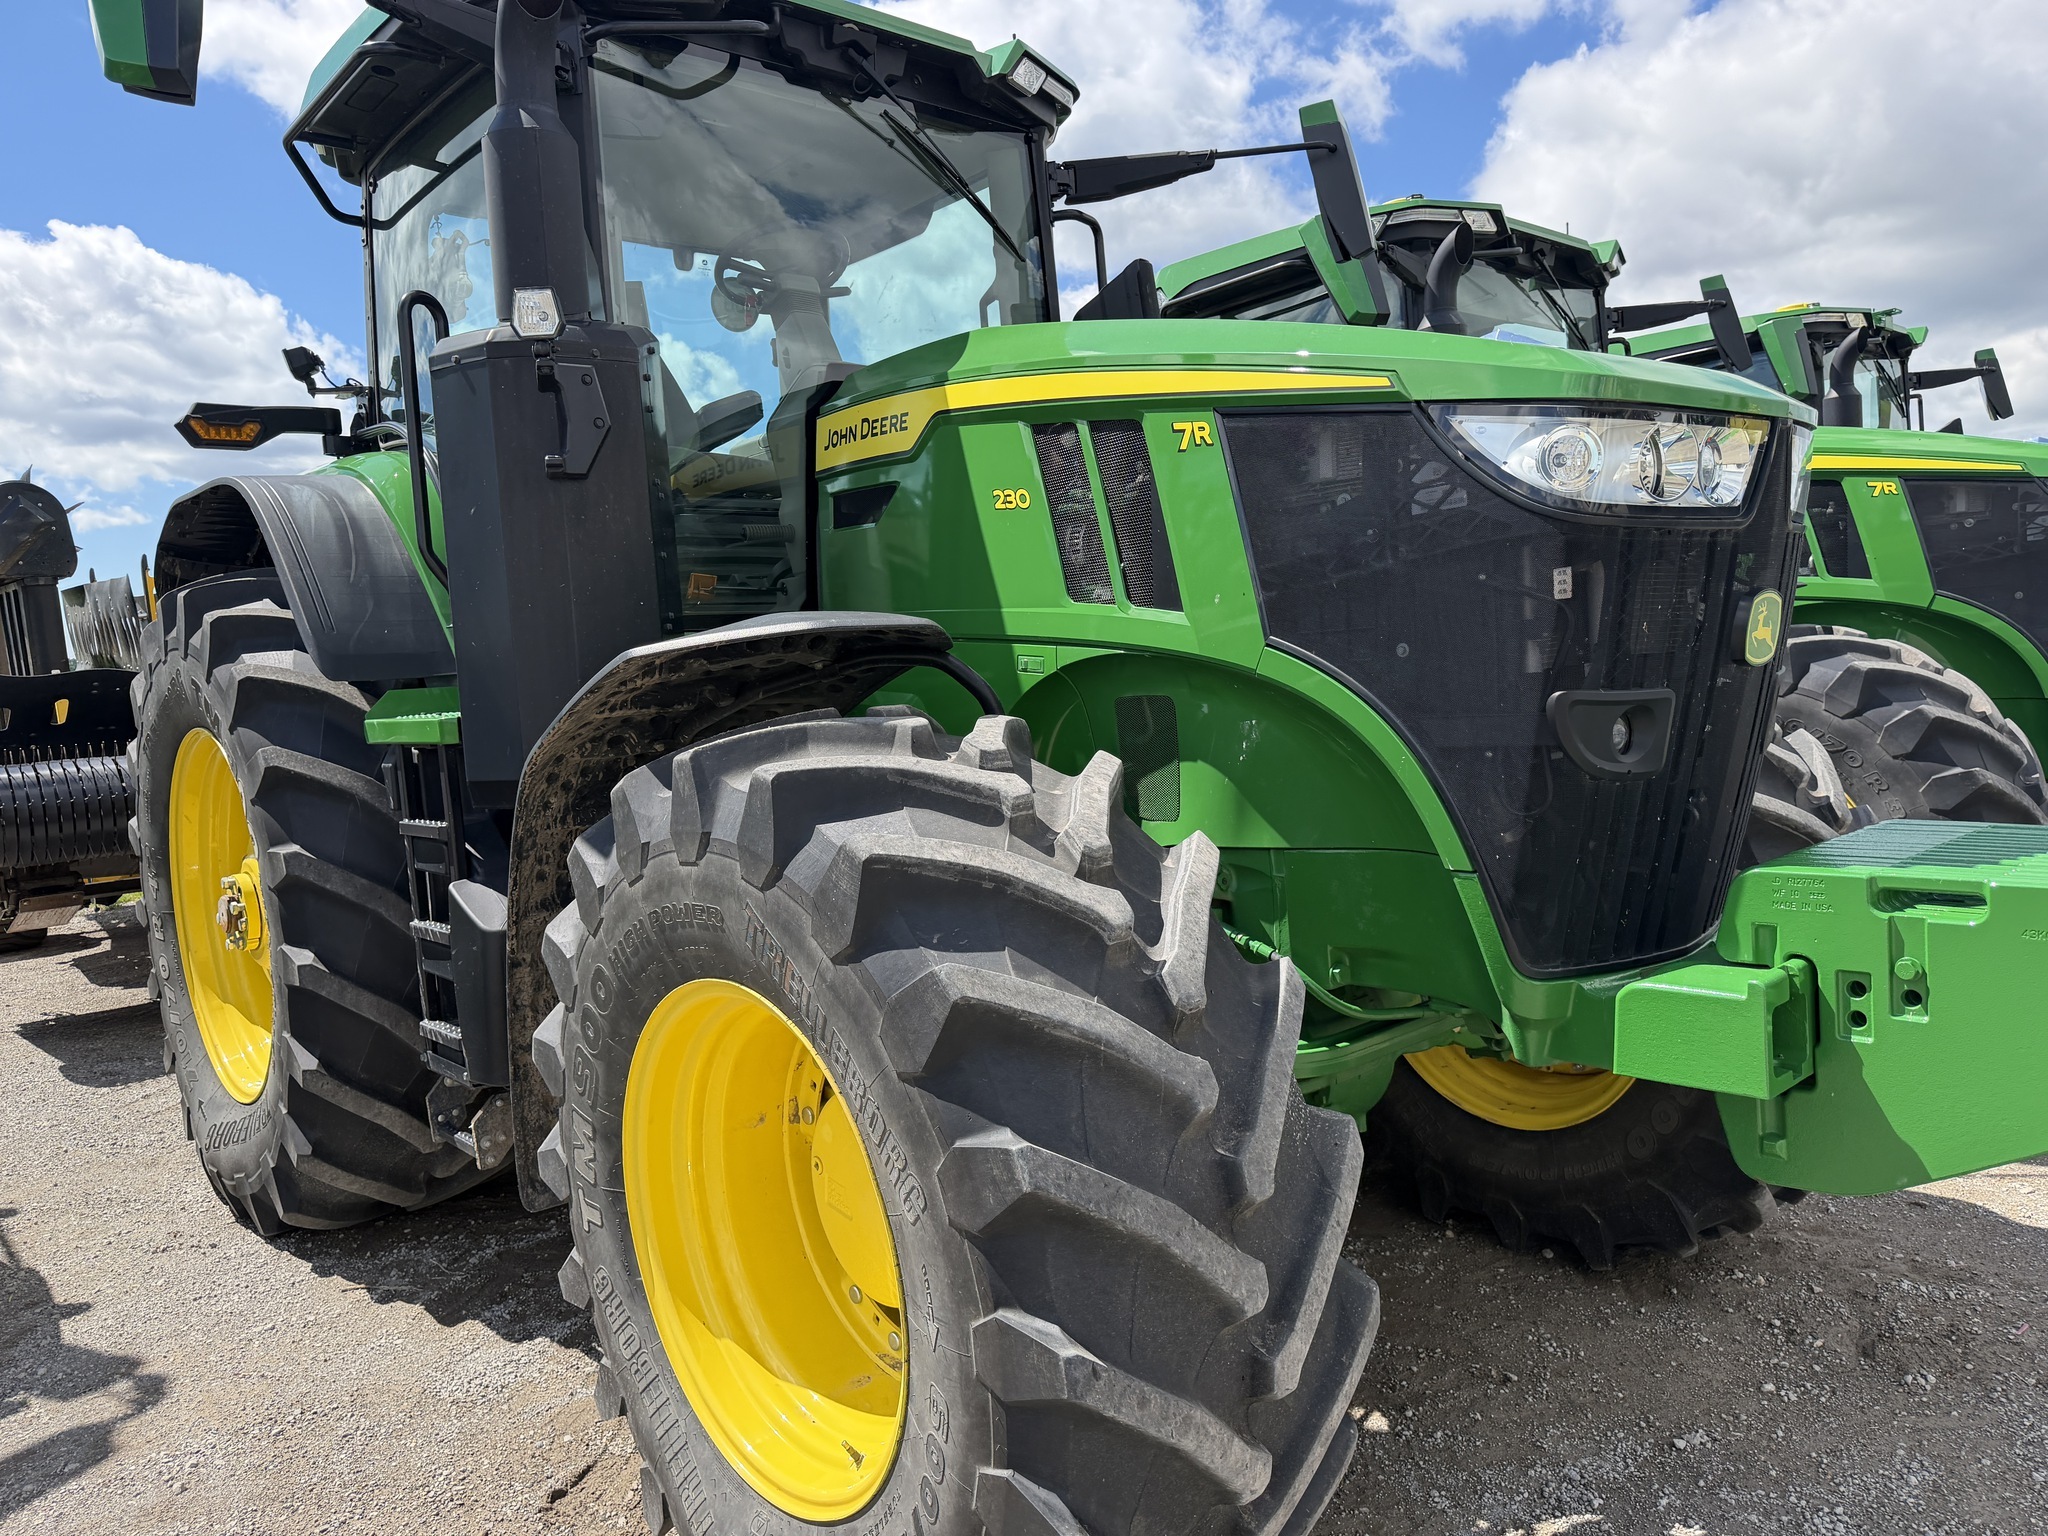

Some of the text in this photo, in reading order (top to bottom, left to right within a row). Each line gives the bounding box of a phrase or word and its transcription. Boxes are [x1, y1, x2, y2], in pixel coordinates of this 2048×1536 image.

[824, 411, 909, 451] JOHN DEERE
[1171, 420, 1214, 453] 7R
[992, 488, 1031, 510] 230
[1866, 481, 1899, 497] 7R
[1772, 901, 1834, 913] MADE IN USA
[608, 916, 648, 976] HIGH
[647, 901, 725, 932] POWER
[158, 954, 199, 1093] 710/70
[745, 901, 928, 1226] TRELLEBORG
